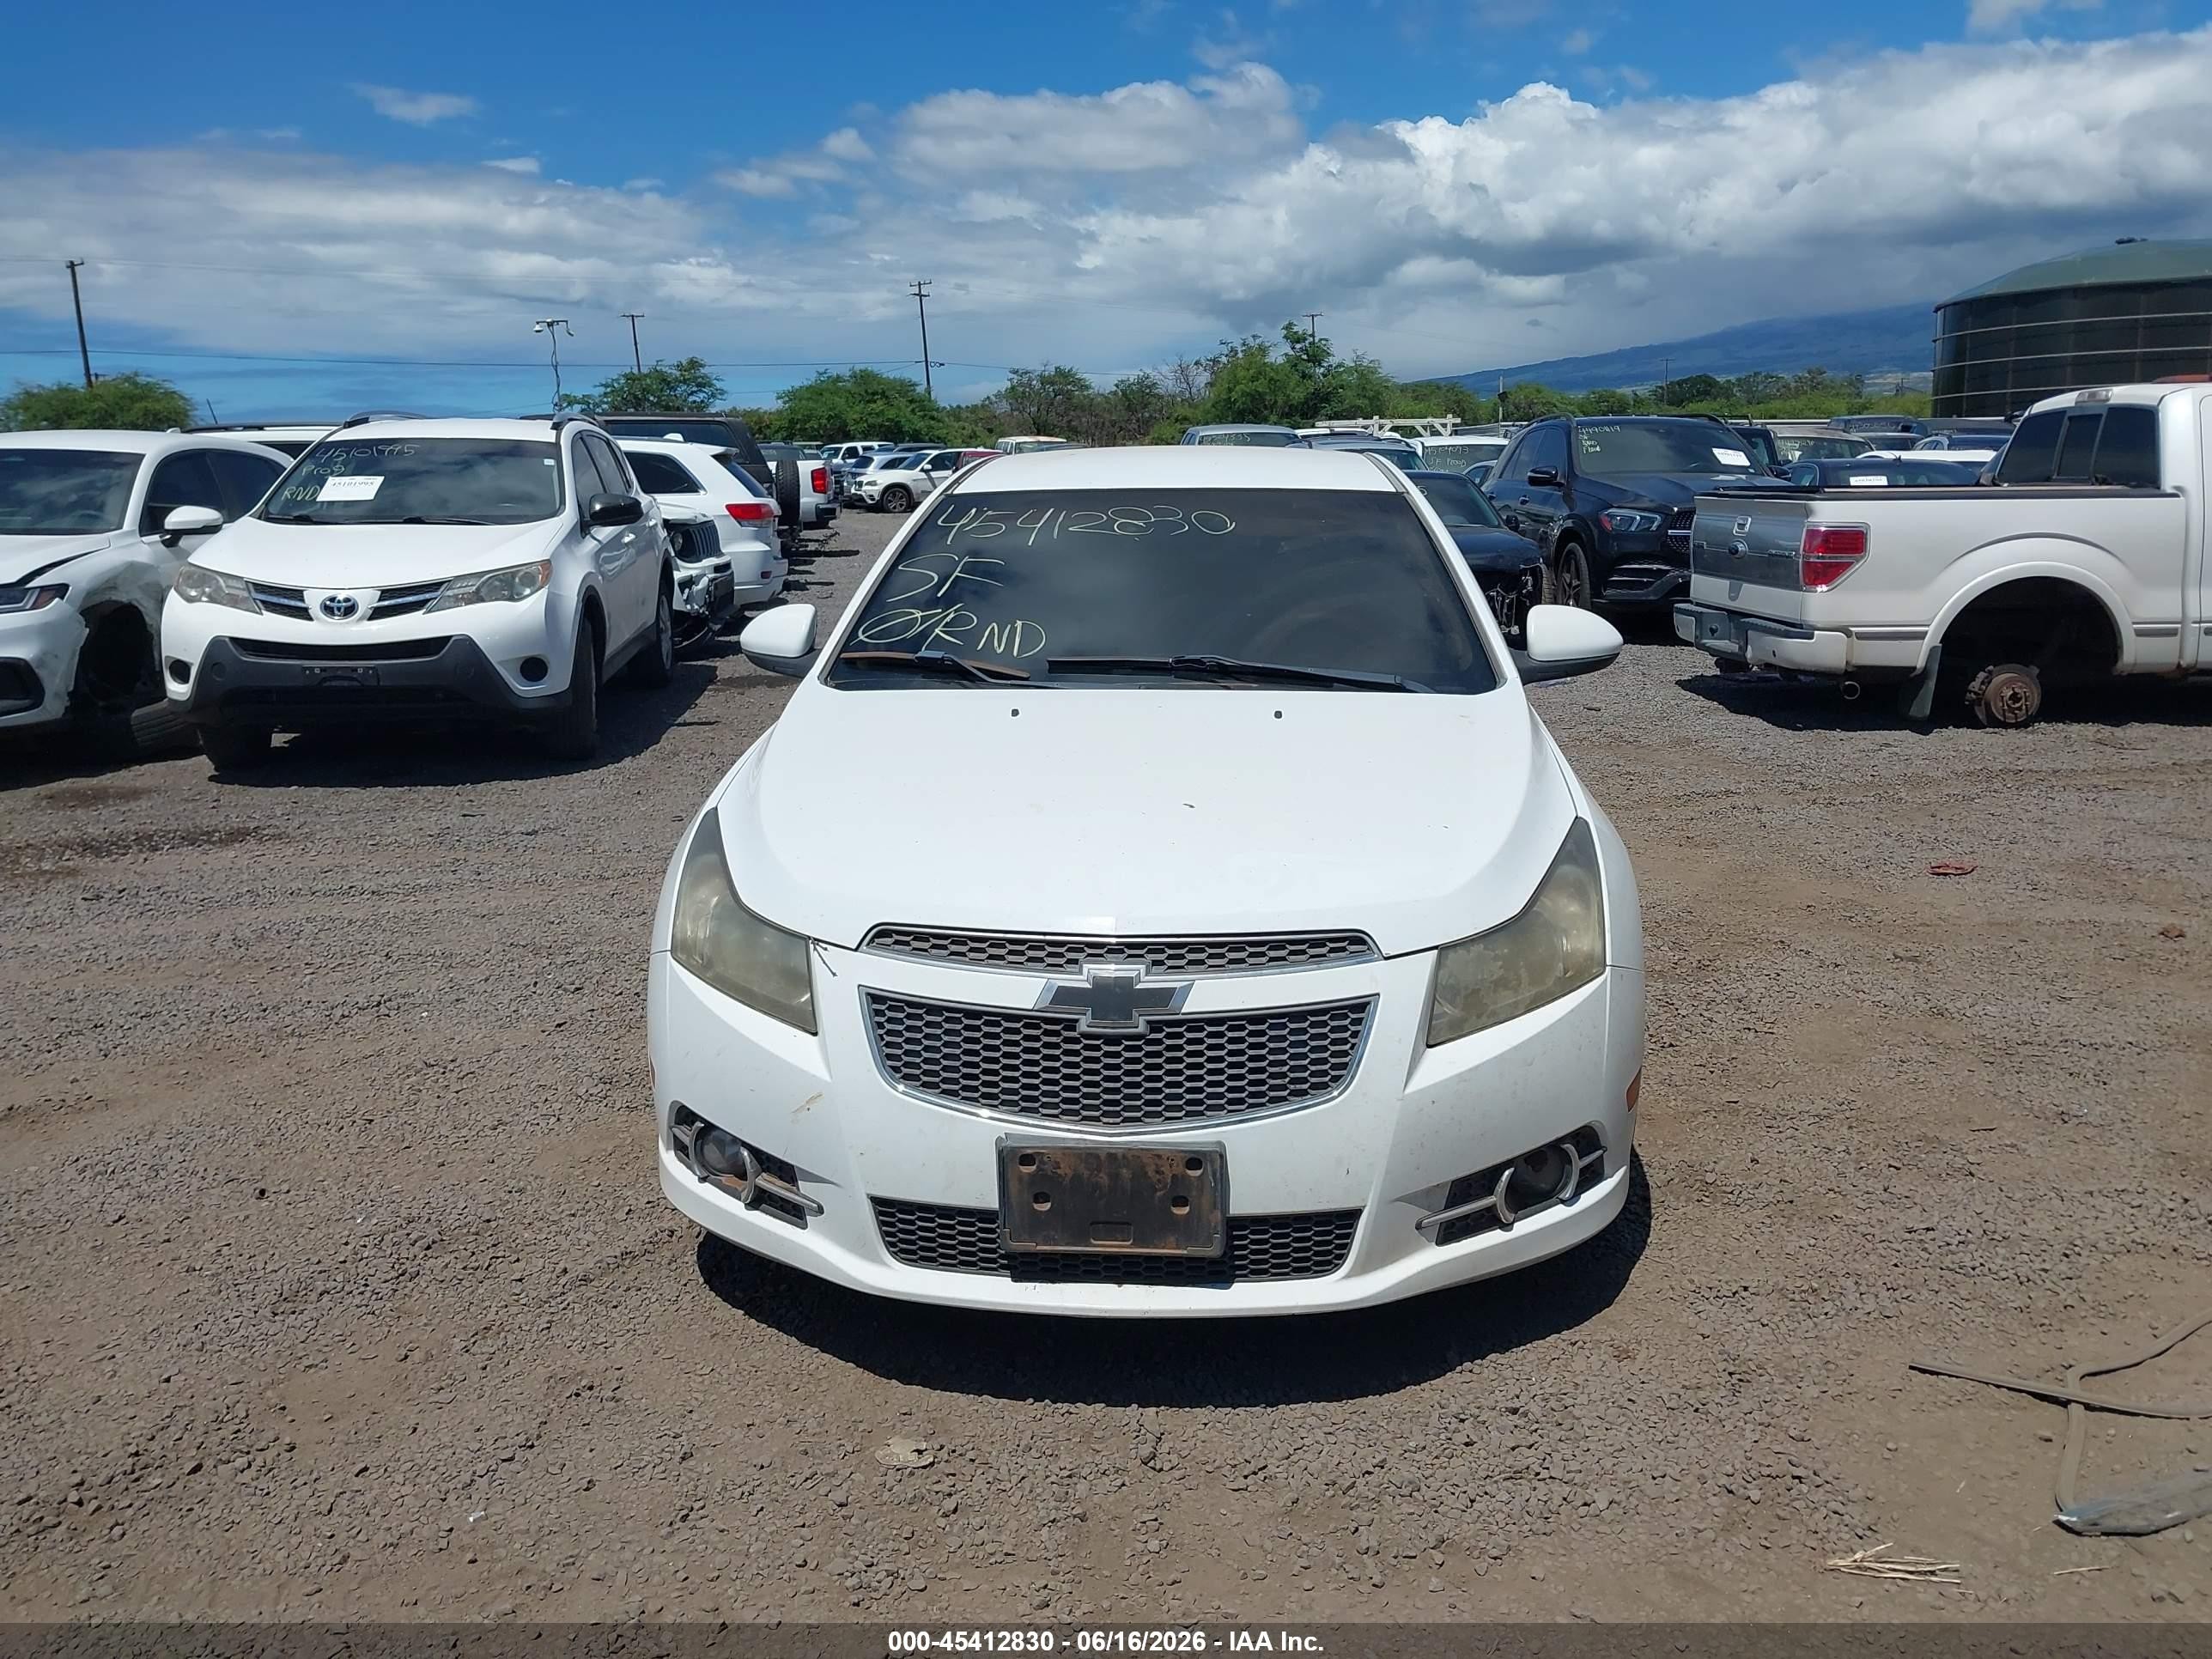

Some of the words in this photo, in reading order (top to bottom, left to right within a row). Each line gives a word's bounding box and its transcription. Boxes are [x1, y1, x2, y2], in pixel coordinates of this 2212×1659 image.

[315, 444, 420, 464] 45101995
[281, 484, 320, 501] RND
[937, 503, 1236, 546] 45412830
[886, 553, 1006, 602] SF
